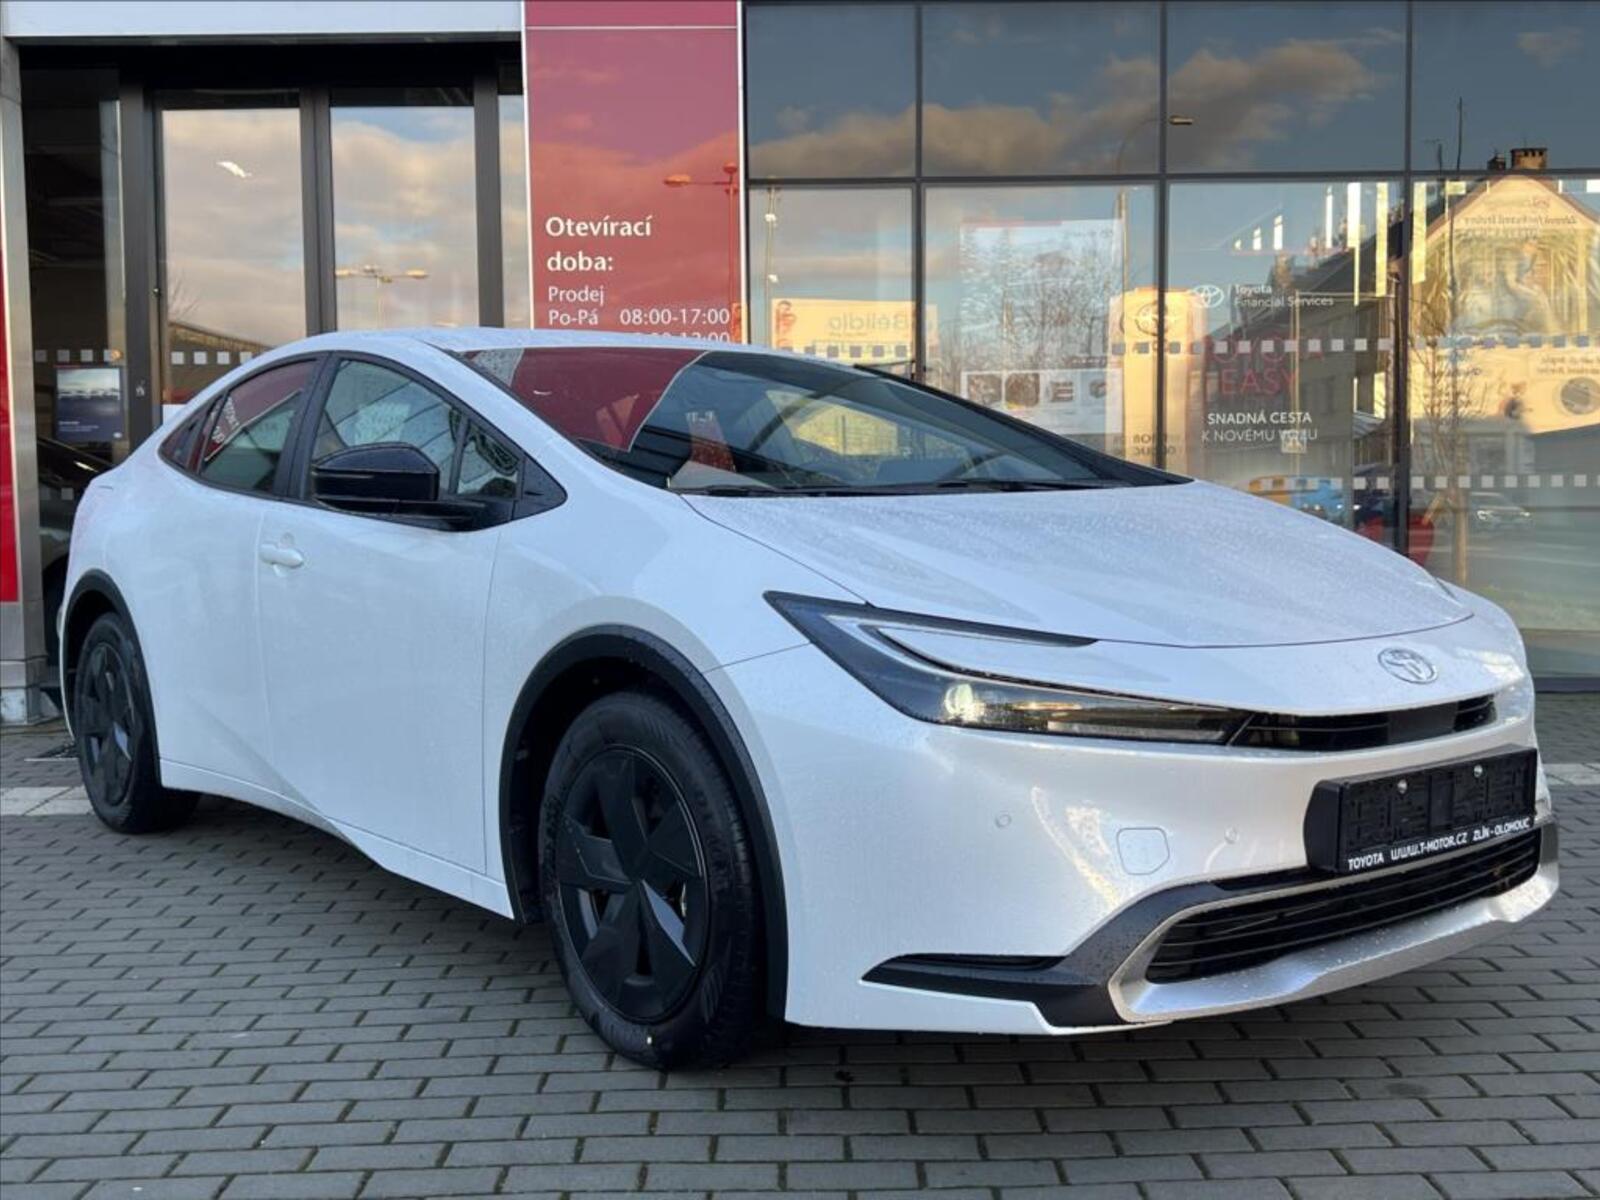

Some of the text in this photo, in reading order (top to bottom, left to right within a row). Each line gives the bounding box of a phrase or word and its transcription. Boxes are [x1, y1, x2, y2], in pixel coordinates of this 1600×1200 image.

[545, 215, 653, 237] Otevírací
[547, 251, 613, 271] doba:
[548, 285, 604, 305] Prodej
[1235, 284, 1272, 297] Toyota
[1234, 296, 1334, 307] Financial Services
[548, 308, 730, 325] Po-Pá 08:00-17:00
[1207, 409, 1312, 425] SNADNÁ CESTA
[1201, 429, 1210, 443] K
[1214, 428, 1275, 442] NOVÉMU
[1348, 852, 1385, 871] TOYOTA
